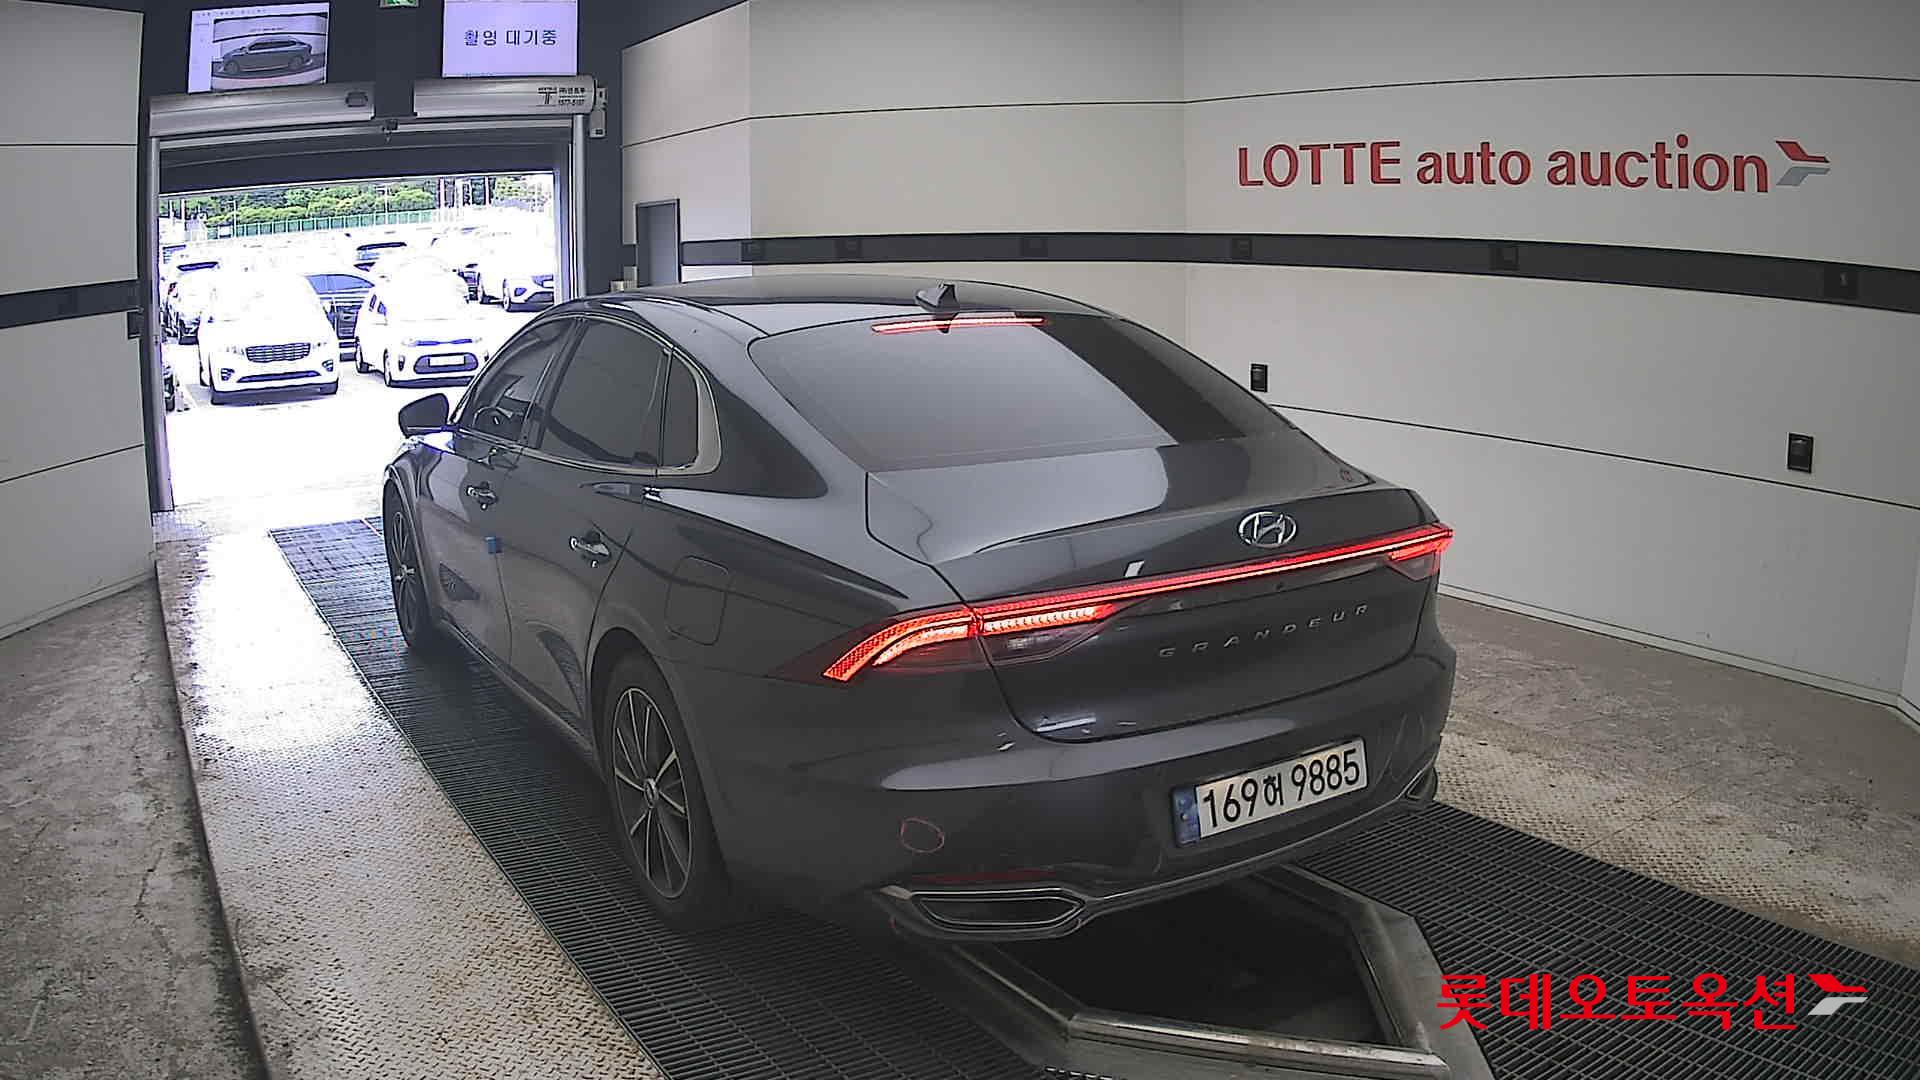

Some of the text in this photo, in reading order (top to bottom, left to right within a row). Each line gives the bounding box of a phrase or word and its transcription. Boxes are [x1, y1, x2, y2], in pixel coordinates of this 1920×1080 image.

[506, 29, 557, 46] 대기중
[1238, 133, 1769, 193] LOTTE auto auction
[1159, 602, 1368, 658] GRANDEUR
[1203, 748, 1360, 828] 169허 9885
